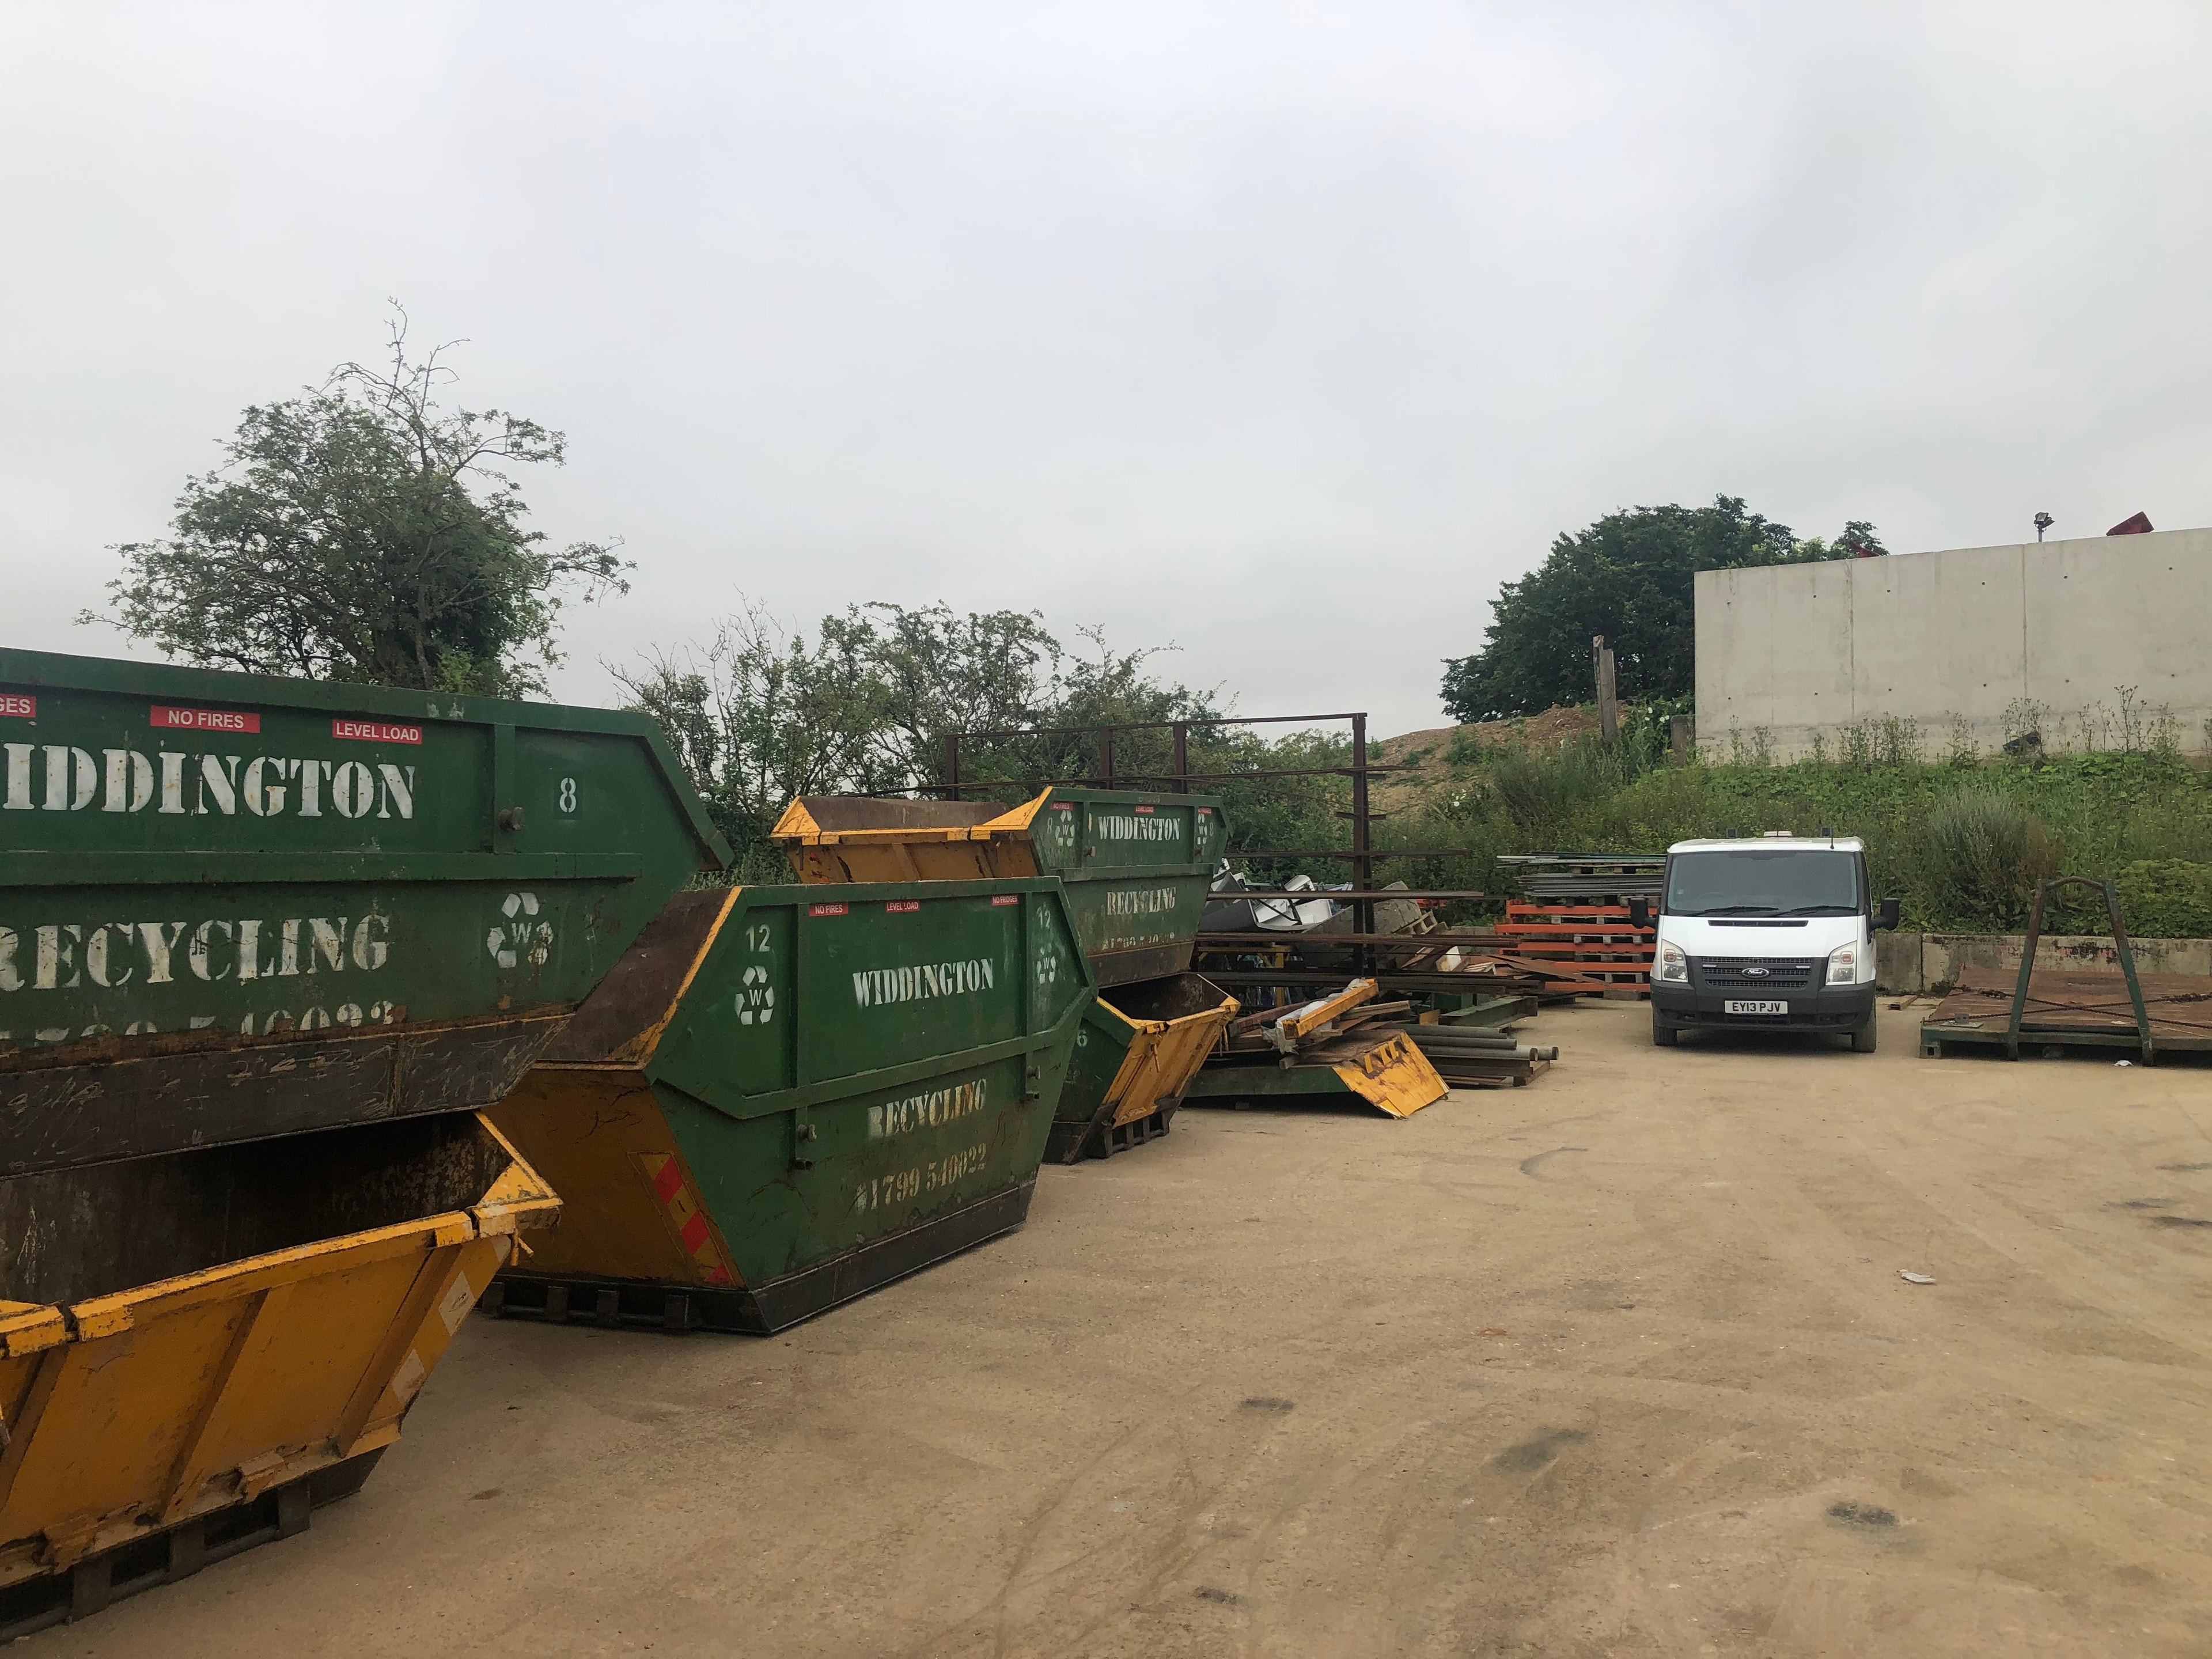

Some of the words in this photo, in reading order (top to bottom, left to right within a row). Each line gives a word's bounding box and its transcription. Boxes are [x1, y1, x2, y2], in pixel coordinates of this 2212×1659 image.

[168, 710, 193, 725] NO
[198, 712, 244, 729] FIRES
[336, 722, 379, 738] LEVEL
[382, 726, 419, 741] LOAD
[3, 743, 415, 819] IDDINGTON
[560, 777, 576, 813] 8
[1062, 824, 1069, 835] W
[1097, 816, 1180, 840] WIDDINGTON
[815, 906, 824, 914] NO
[825, 904, 843, 913] FIRES
[887, 903, 903, 911] LEVEL
[993, 896, 1000, 904] NO
[1001, 895, 1018, 904] FRIDGES
[745, 923, 771, 952] 12
[853, 959, 994, 1008] WIDDINGTON
[749, 989, 763, 1006] W
[1732, 1002, 1756, 1012] EY13
[1759, 1003, 1781, 1012] PJV
[868, 1078, 987, 1138] RECYCLING
